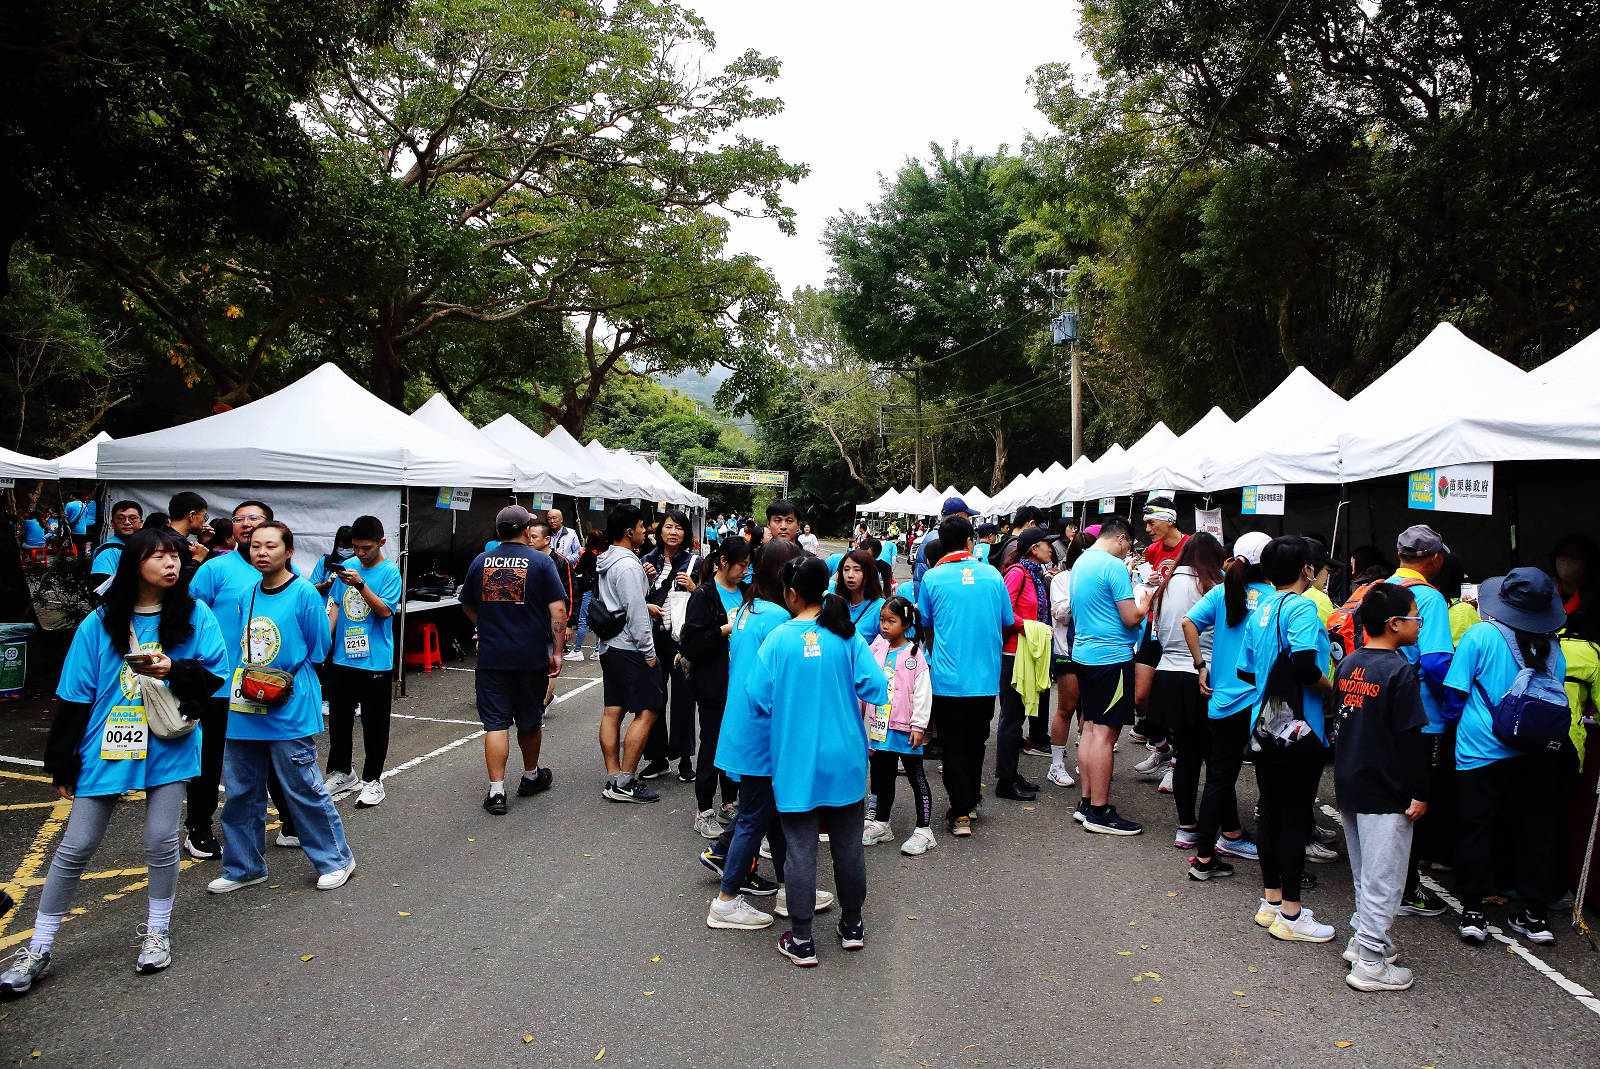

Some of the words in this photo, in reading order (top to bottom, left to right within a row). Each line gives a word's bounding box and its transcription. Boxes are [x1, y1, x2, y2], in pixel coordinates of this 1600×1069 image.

[1411, 472, 1434, 481] MIAOLI
[1412, 482, 1424, 491] FUN
[1449, 479, 1489, 492] 苗栗縣政府
[1411, 492, 1433, 502] YOUNG
[484, 557, 529, 568] DICKIES
[346, 639, 366, 649] 2219
[1350, 667, 1366, 681] ALL
[106, 730, 143, 743] 0042
